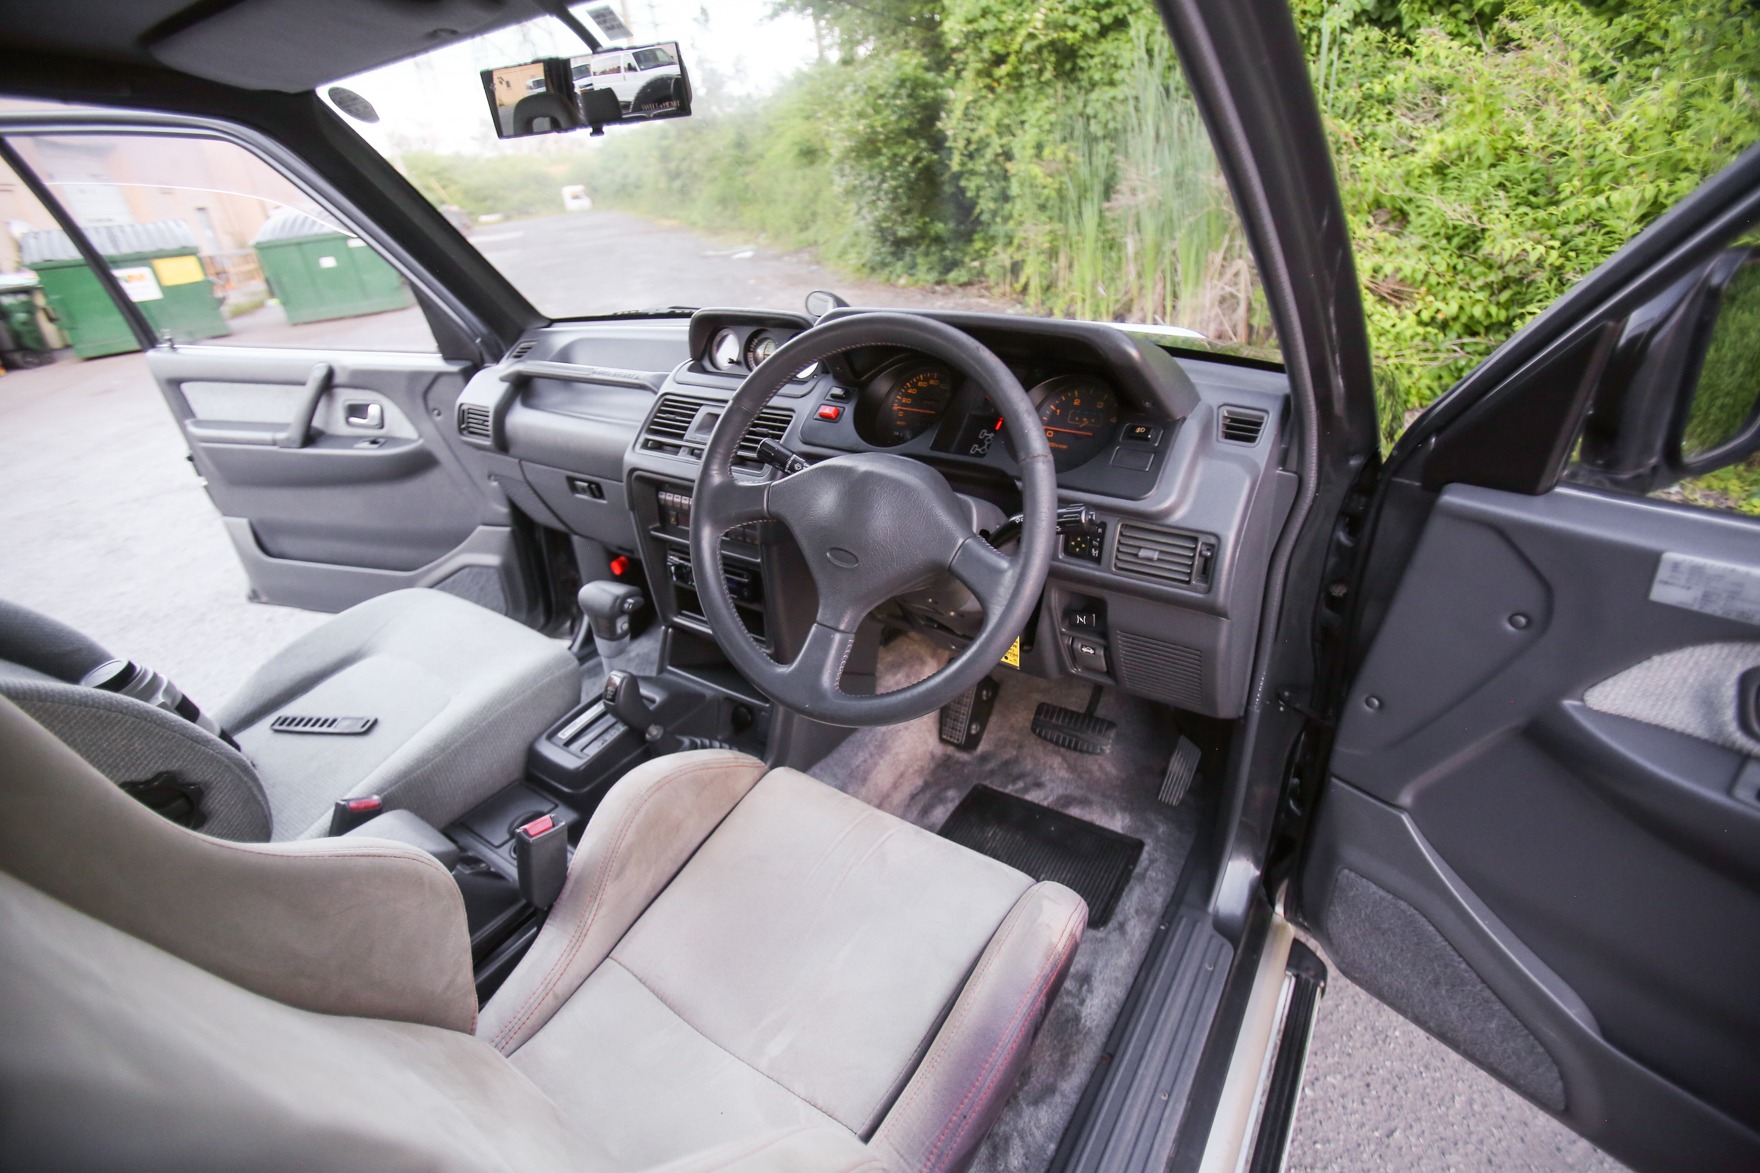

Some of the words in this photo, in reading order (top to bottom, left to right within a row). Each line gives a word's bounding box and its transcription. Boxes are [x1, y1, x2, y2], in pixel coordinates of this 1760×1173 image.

[1073, 398, 1081, 406] 2
[1096, 401, 1105, 409] 3
[1046, 430, 1054, 438] 0
